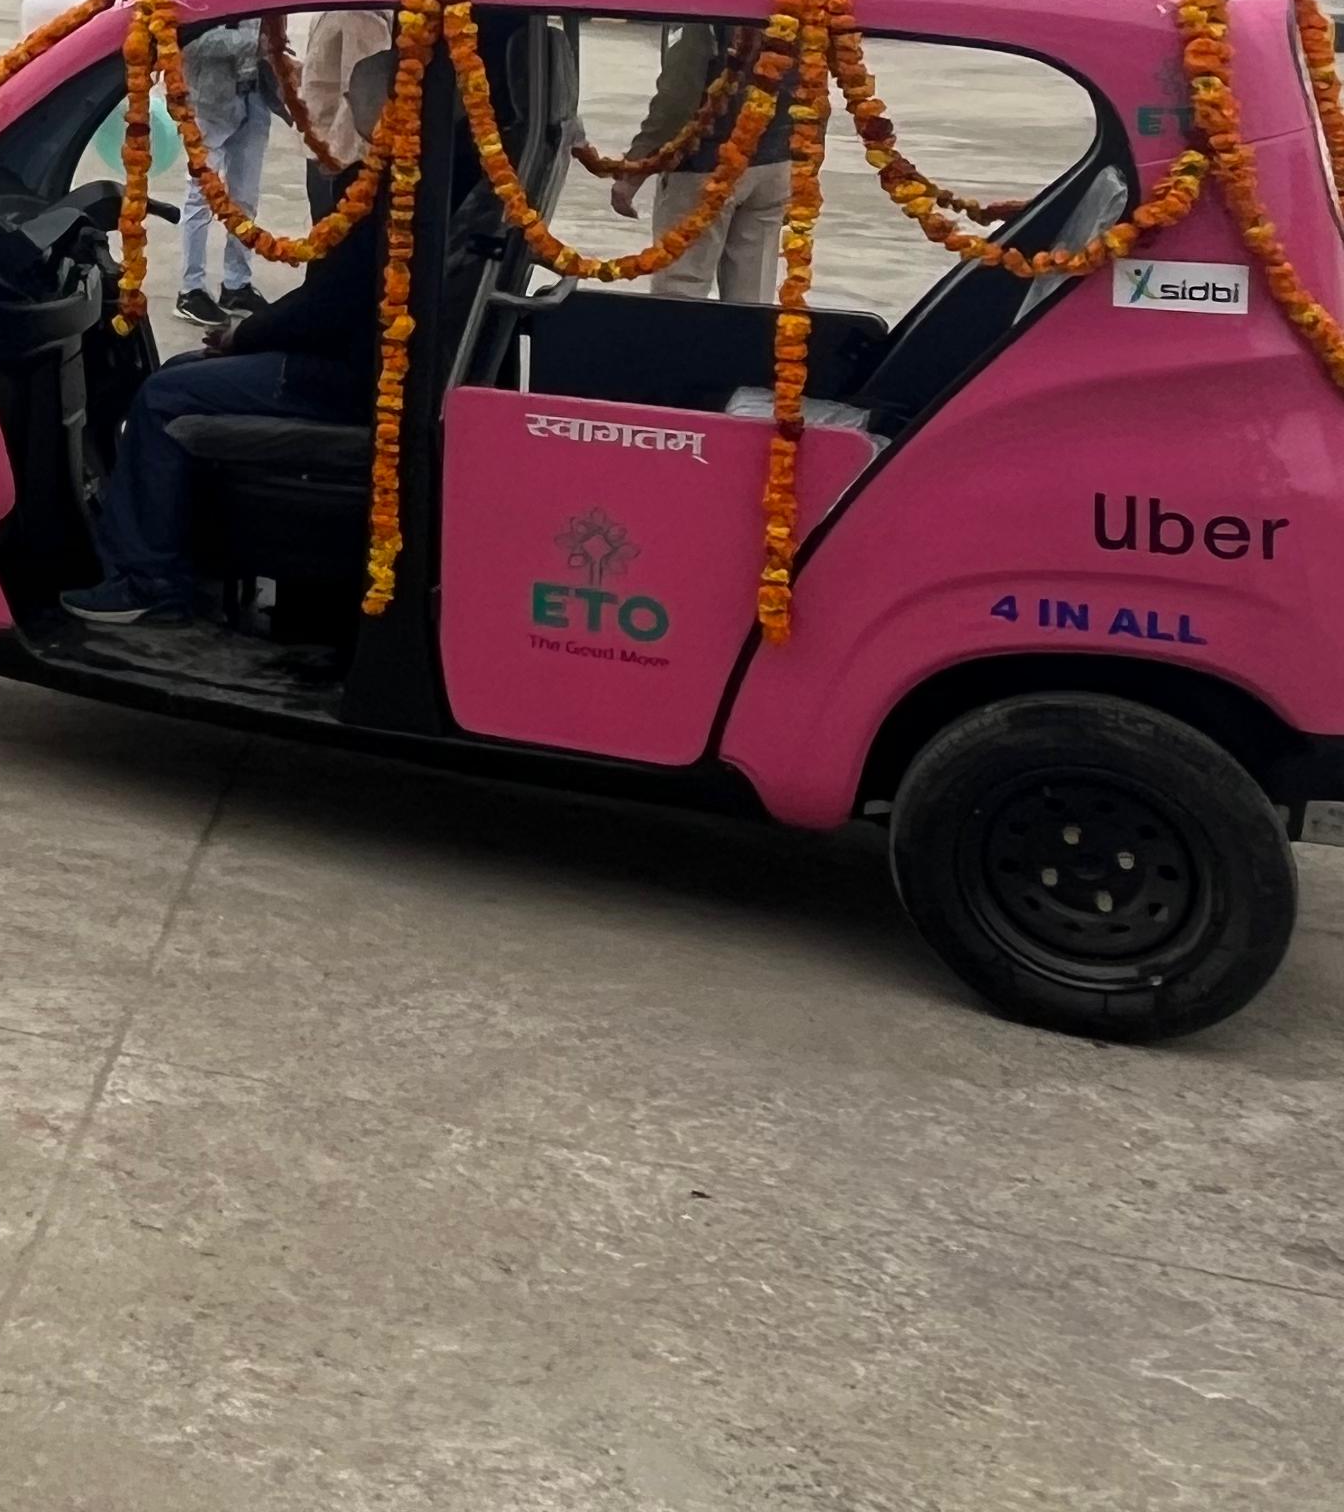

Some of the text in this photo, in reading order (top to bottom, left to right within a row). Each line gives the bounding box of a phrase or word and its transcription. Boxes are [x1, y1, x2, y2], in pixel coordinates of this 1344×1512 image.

[1160, 280, 1240, 303] sidbi
[525, 413, 709, 464] स्वागतम्
[1094, 492, 1290, 560] Uber
[532, 582, 670, 642] ETO
[990, 595, 1208, 645] 4 IN ALL
